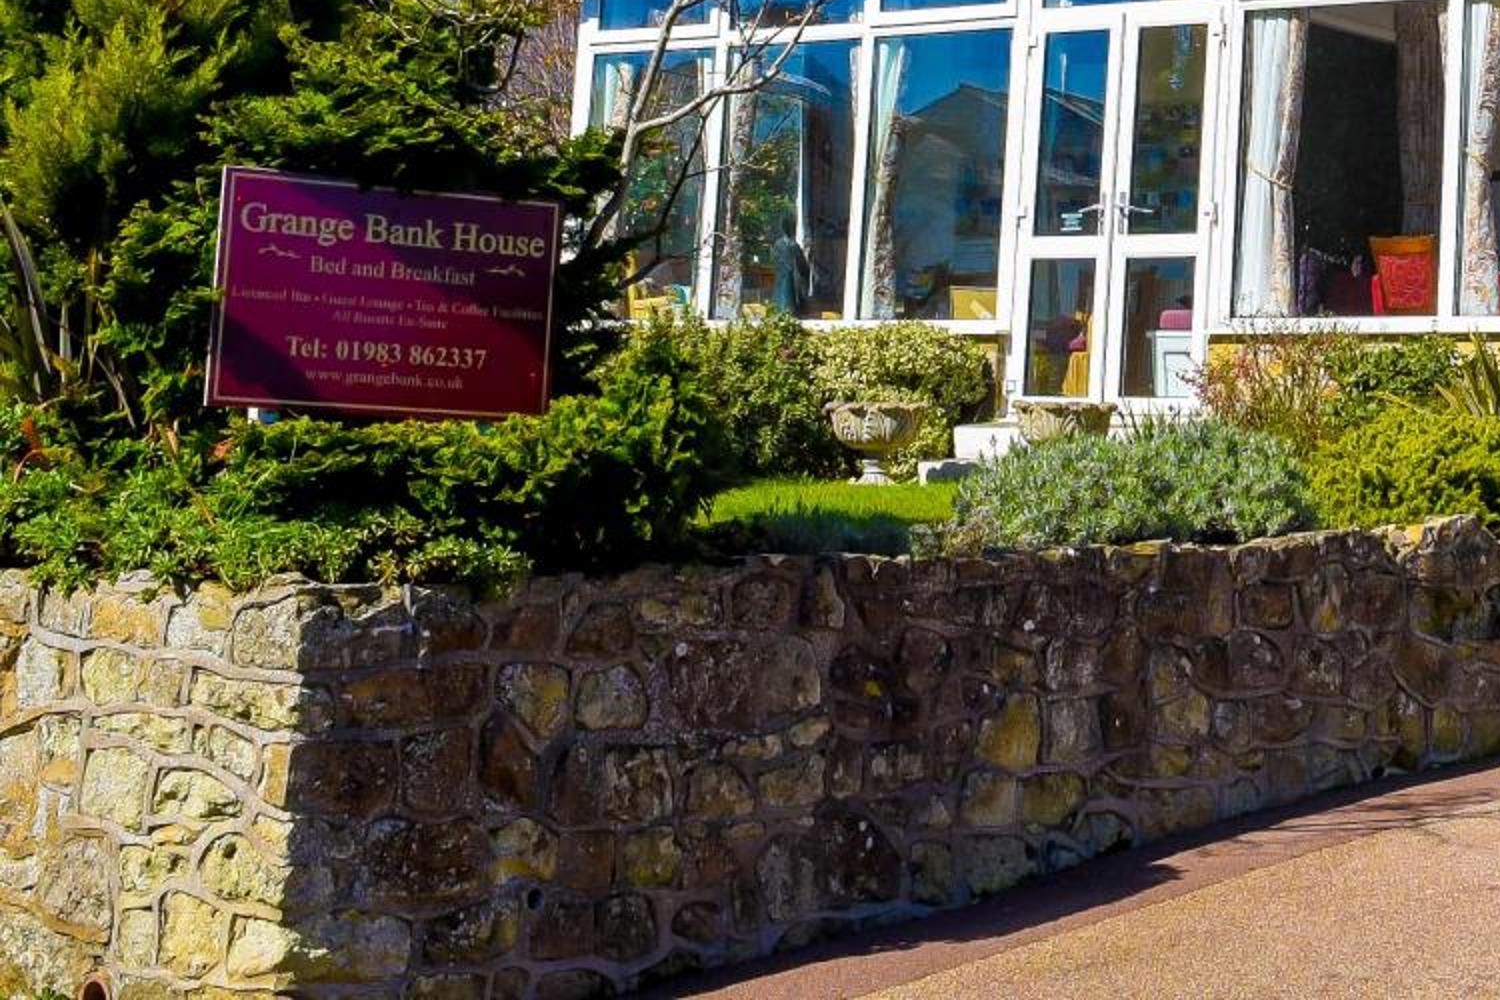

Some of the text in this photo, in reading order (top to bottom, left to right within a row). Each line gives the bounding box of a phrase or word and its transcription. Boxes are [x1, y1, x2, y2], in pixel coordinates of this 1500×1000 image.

[240, 202, 545, 257] Grange Bank House
[311, 255, 475, 285] Bed and Breakfast
[286, 336, 487, 370] Tel: 01983 862337
[305, 369, 464, 390] www.grangebank.co.uk
